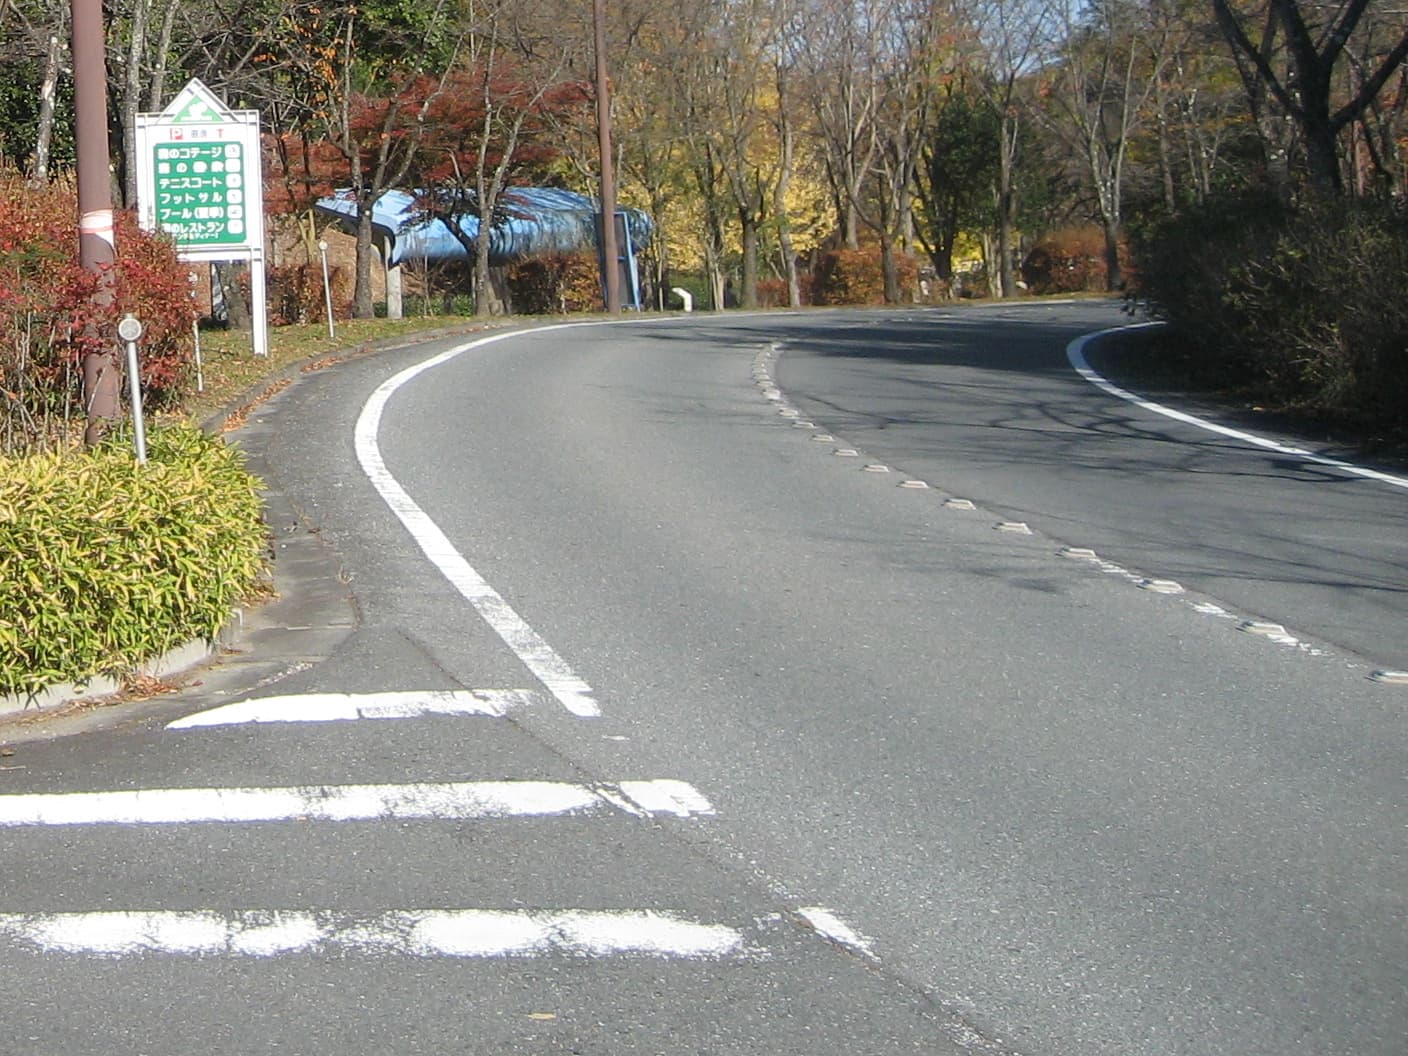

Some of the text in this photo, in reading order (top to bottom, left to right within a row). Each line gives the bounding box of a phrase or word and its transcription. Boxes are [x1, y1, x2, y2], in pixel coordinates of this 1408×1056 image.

[158, 146, 222, 159] のコテージ
[159, 175, 223, 189] テニスコート
[159, 191, 223, 204] フットサル
[161, 221, 225, 233] のレストラン
